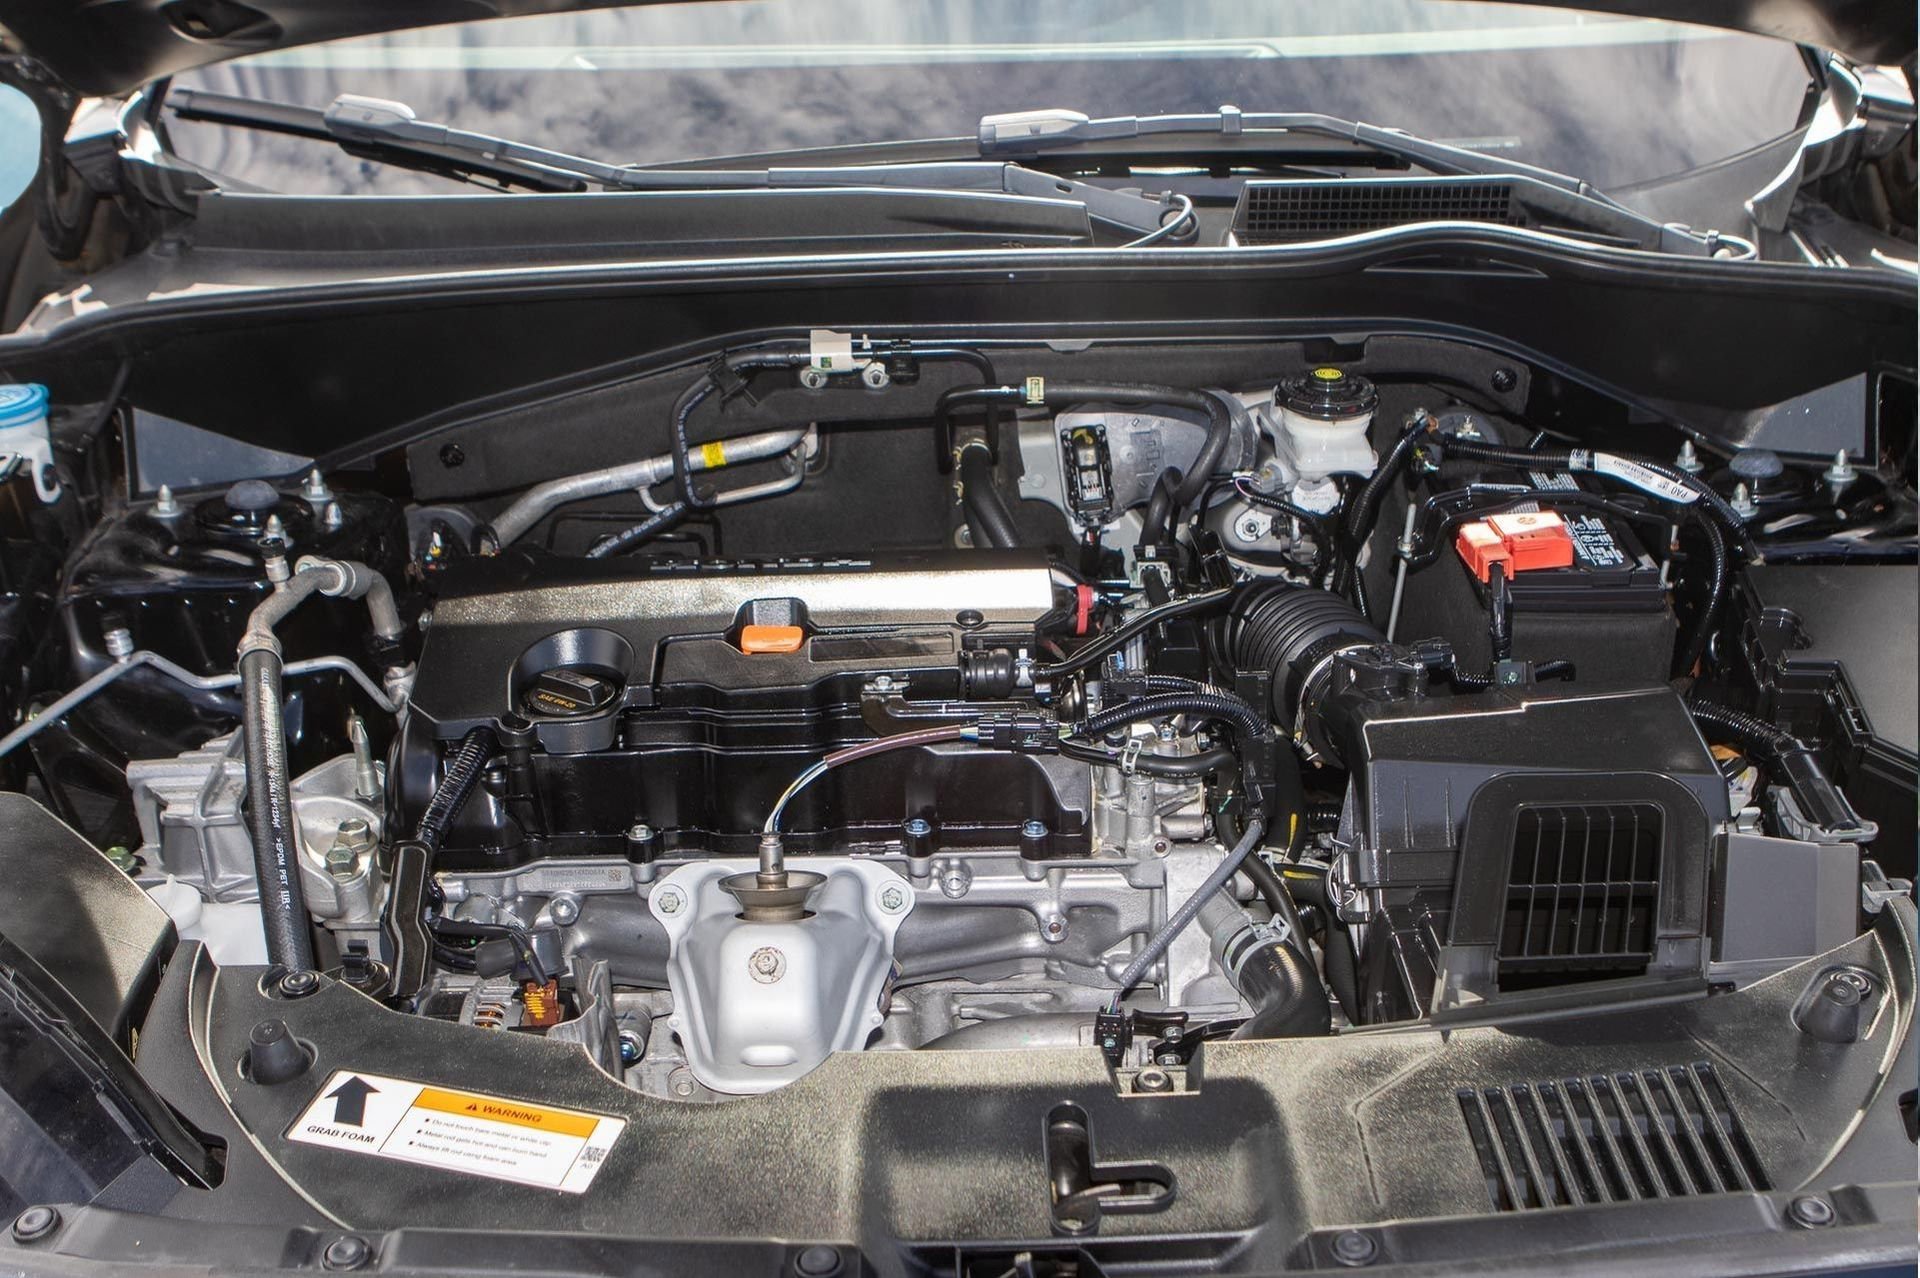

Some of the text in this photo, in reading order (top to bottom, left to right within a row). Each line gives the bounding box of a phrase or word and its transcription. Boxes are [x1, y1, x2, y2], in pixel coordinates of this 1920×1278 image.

[279, 869, 289, 886] PET
[483, 1105, 543, 1123] WARNING
[307, 1125, 375, 1143] GRAB FOAM
